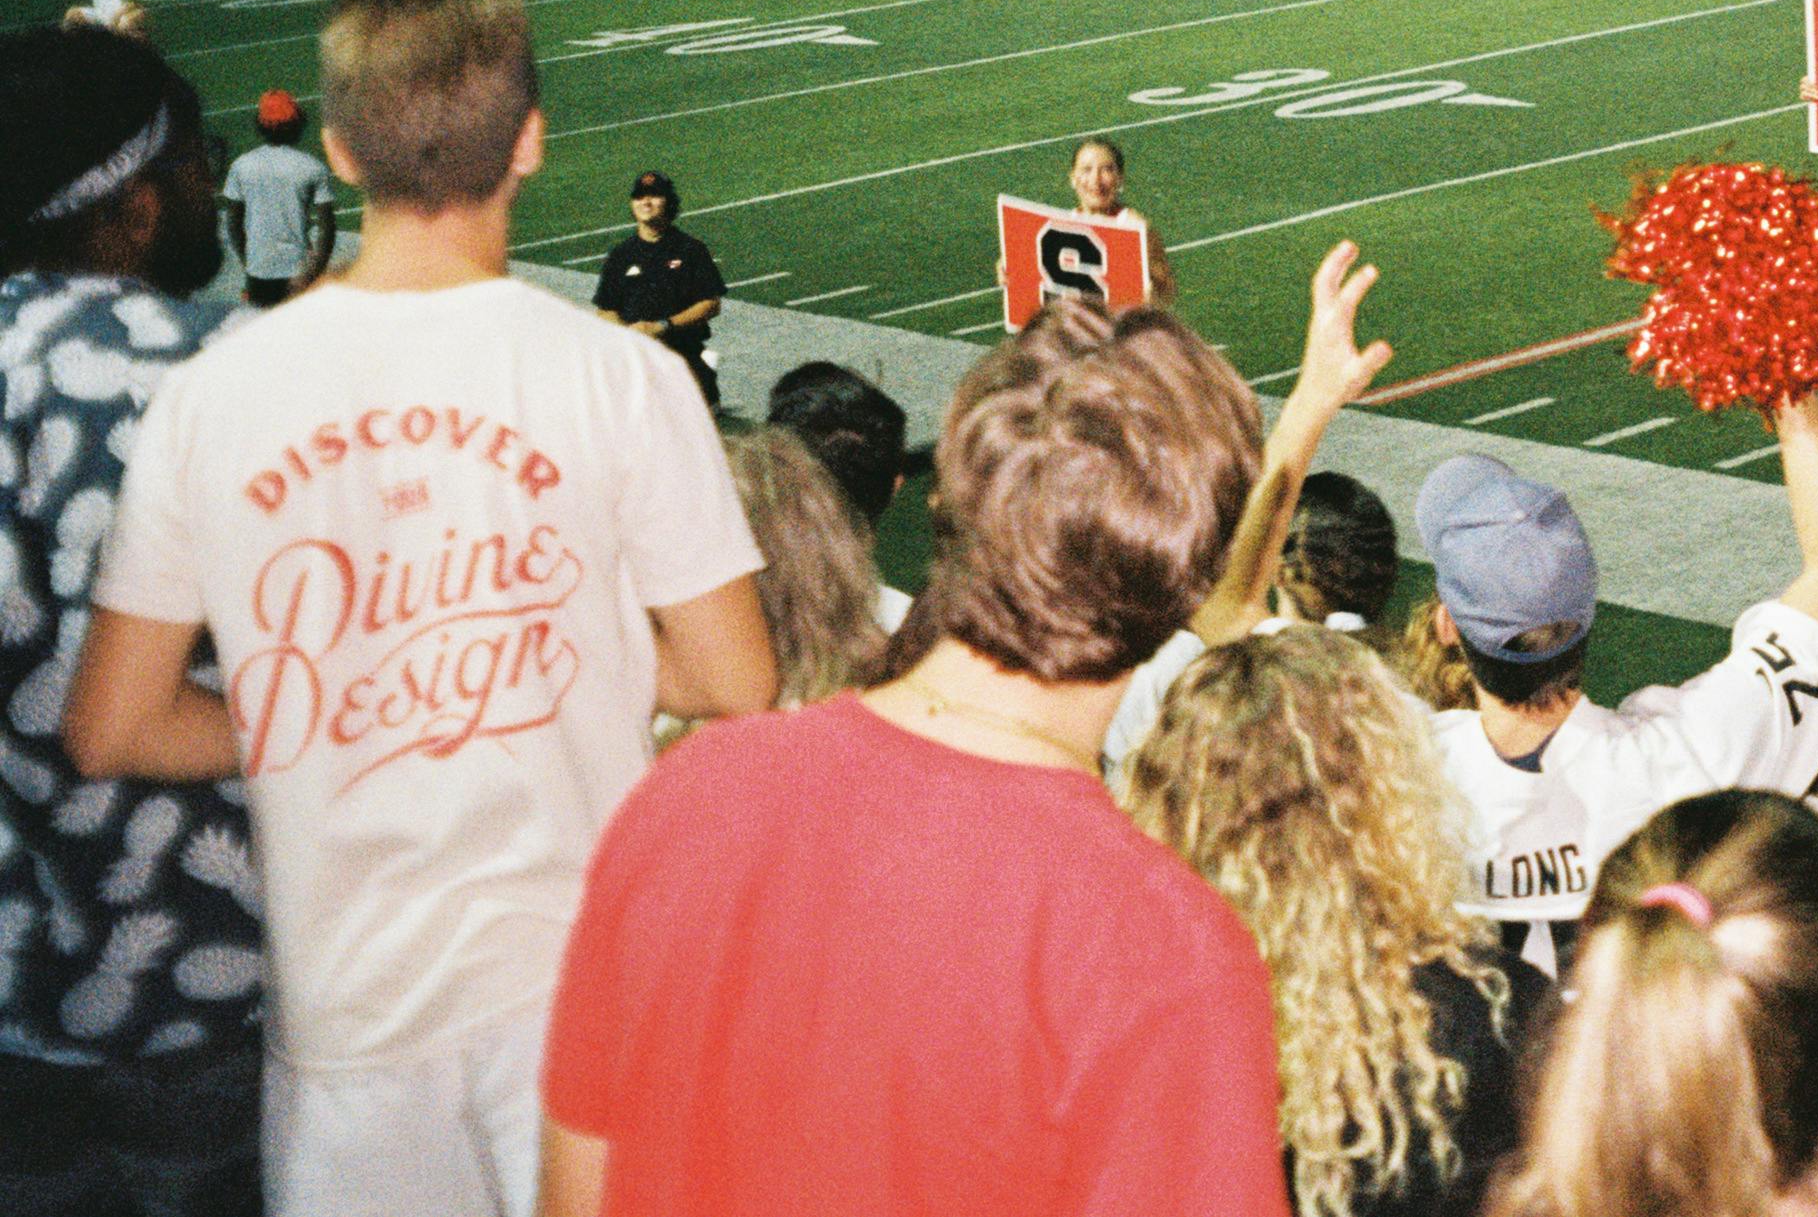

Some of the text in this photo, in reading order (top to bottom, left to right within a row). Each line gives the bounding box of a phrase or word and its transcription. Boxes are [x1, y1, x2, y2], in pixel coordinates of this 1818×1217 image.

[1126, 67, 1468, 119] 30
[1036, 222, 1109, 305] S
[244, 404, 562, 516] DISCOVER
[251, 524, 583, 664] Divine
[230, 619, 581, 779] Design
